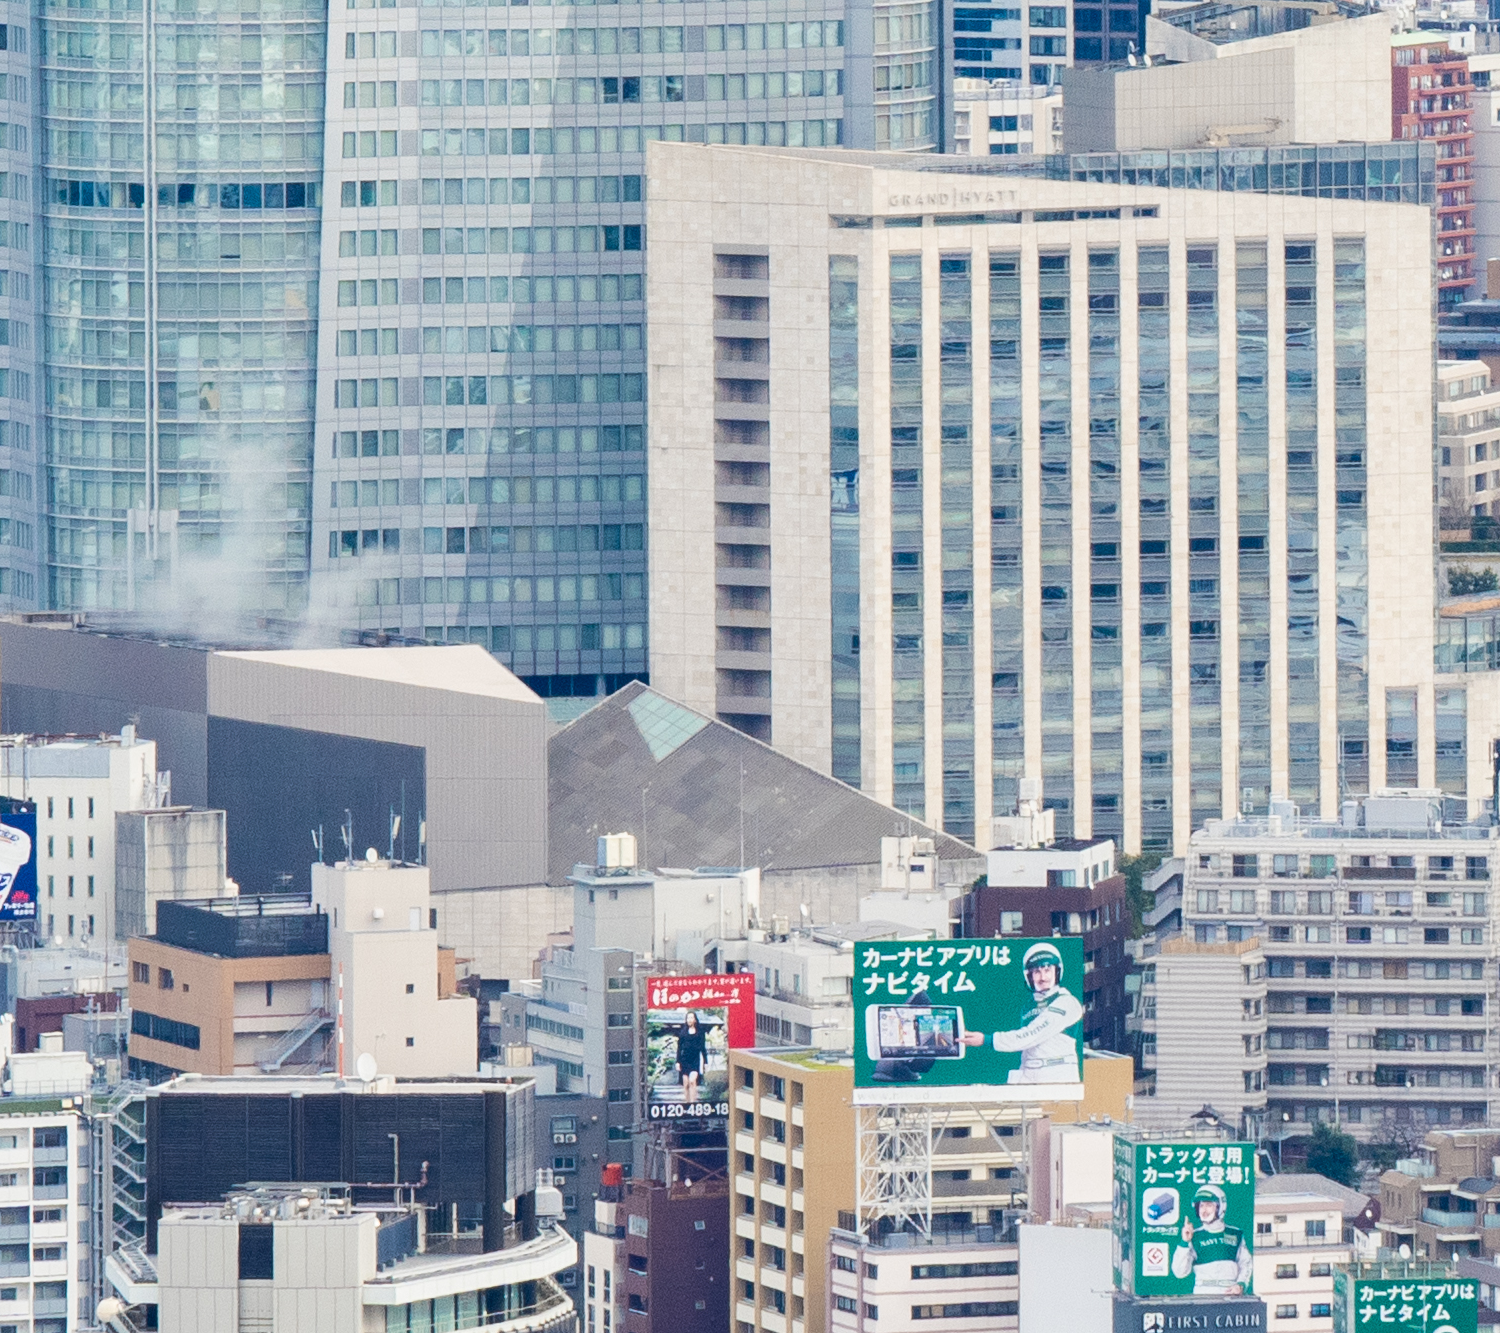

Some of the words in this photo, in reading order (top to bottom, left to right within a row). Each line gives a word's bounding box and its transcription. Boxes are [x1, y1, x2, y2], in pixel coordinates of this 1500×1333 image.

[889, 192, 949, 207] GRAND
[960, 189, 1018, 203] HYATT
[862, 971, 976, 995] ナビタイム
[1145, 1147, 1242, 1165] トラック専用
[1142, 1167, 1250, 1185] カーナビ登場!
[1168, 1316, 1208, 1330] FIRST
[1215, 1314, 1260, 1329] CABIN
[1359, 1304, 1451, 1324] ナビタイム
